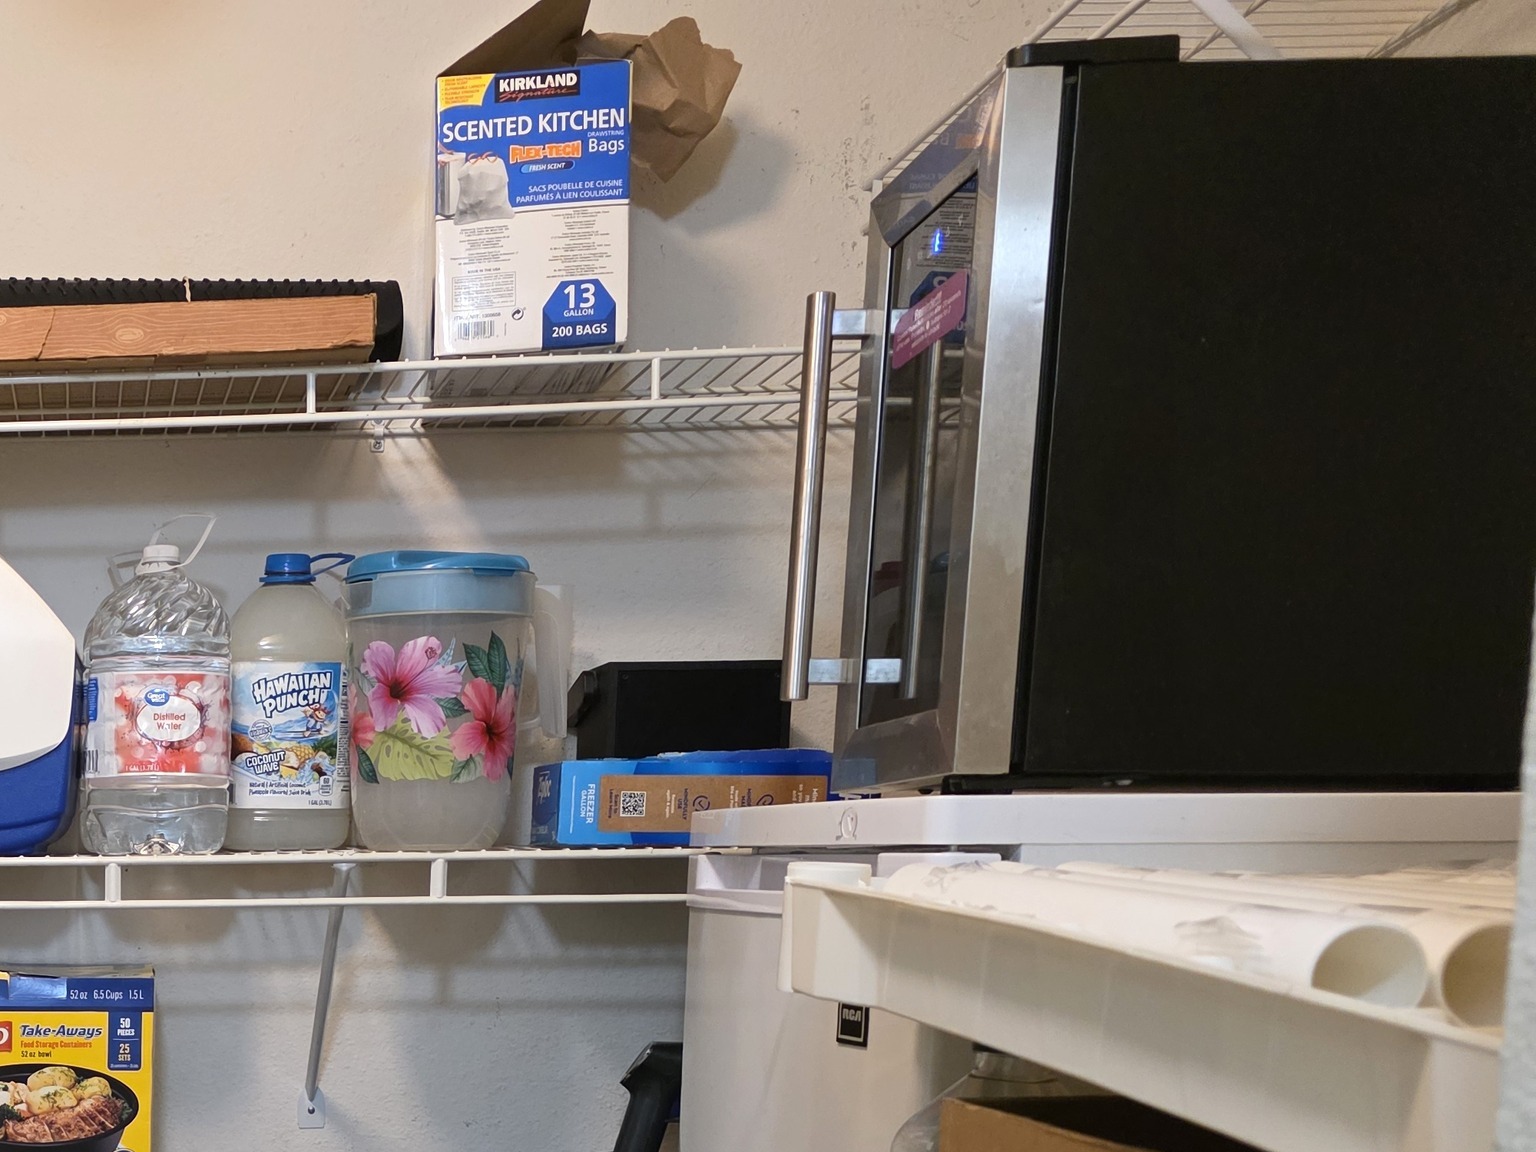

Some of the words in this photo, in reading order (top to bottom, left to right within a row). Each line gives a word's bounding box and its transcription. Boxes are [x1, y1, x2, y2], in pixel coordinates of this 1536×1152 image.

[499, 73, 578, 93] KIRKLAND
[499, 87, 578, 103] Signature
[442, 116, 533, 143] SCENTED
[538, 107, 625, 134] KITCHEN
[587, 129, 625, 138] DRAWSTRING
[509, 140, 582, 164] FLEX-TECH
[588, 138, 625, 155] Bags
[529, 164, 546, 172] FRESH
[547, 162, 566, 170] SCENT
[528, 185, 547, 193] SACS
[547, 182, 583, 192] POUBELLE
[584, 181, 595, 189] DE
[596, 179, 623, 188] CUISINE
[516, 192, 555, 204] PARFUMÉS
[562, 191, 578, 199] LIEN
[579, 188, 624, 198] COULISSANT
[564, 283, 595, 309] 13
[563, 308, 594, 317] GALLON
[552, 326, 572, 338] 200
[576, 323, 608, 336] BAGS
[251, 671, 332, 704] HAWAIIAN
[153, 713, 186, 721] Distilled
[246, 751, 286, 767] COCONUT
[253, 762, 280, 775] WAVE
[585, 783, 596, 824] FREEZER
[69, 991, 79, 1000] 52
[93, 990, 105, 1000] 6.5
[105, 990, 123, 1001] Cups
[128, 990, 138, 1000] 1.5
[138, 990, 144, 999] L
[842, 1008, 862, 1022] RCA
[120, 1017, 131, 1028] 50
[20, 1024, 103, 1038] Take-Aways
[20, 1040, 34, 1048] Food
[35, 1040, 59, 1050] Storage
[60, 1040, 92, 1048] Containers
[119, 1044, 130, 1054] 25
[38, 1050, 52, 1058] bowl
